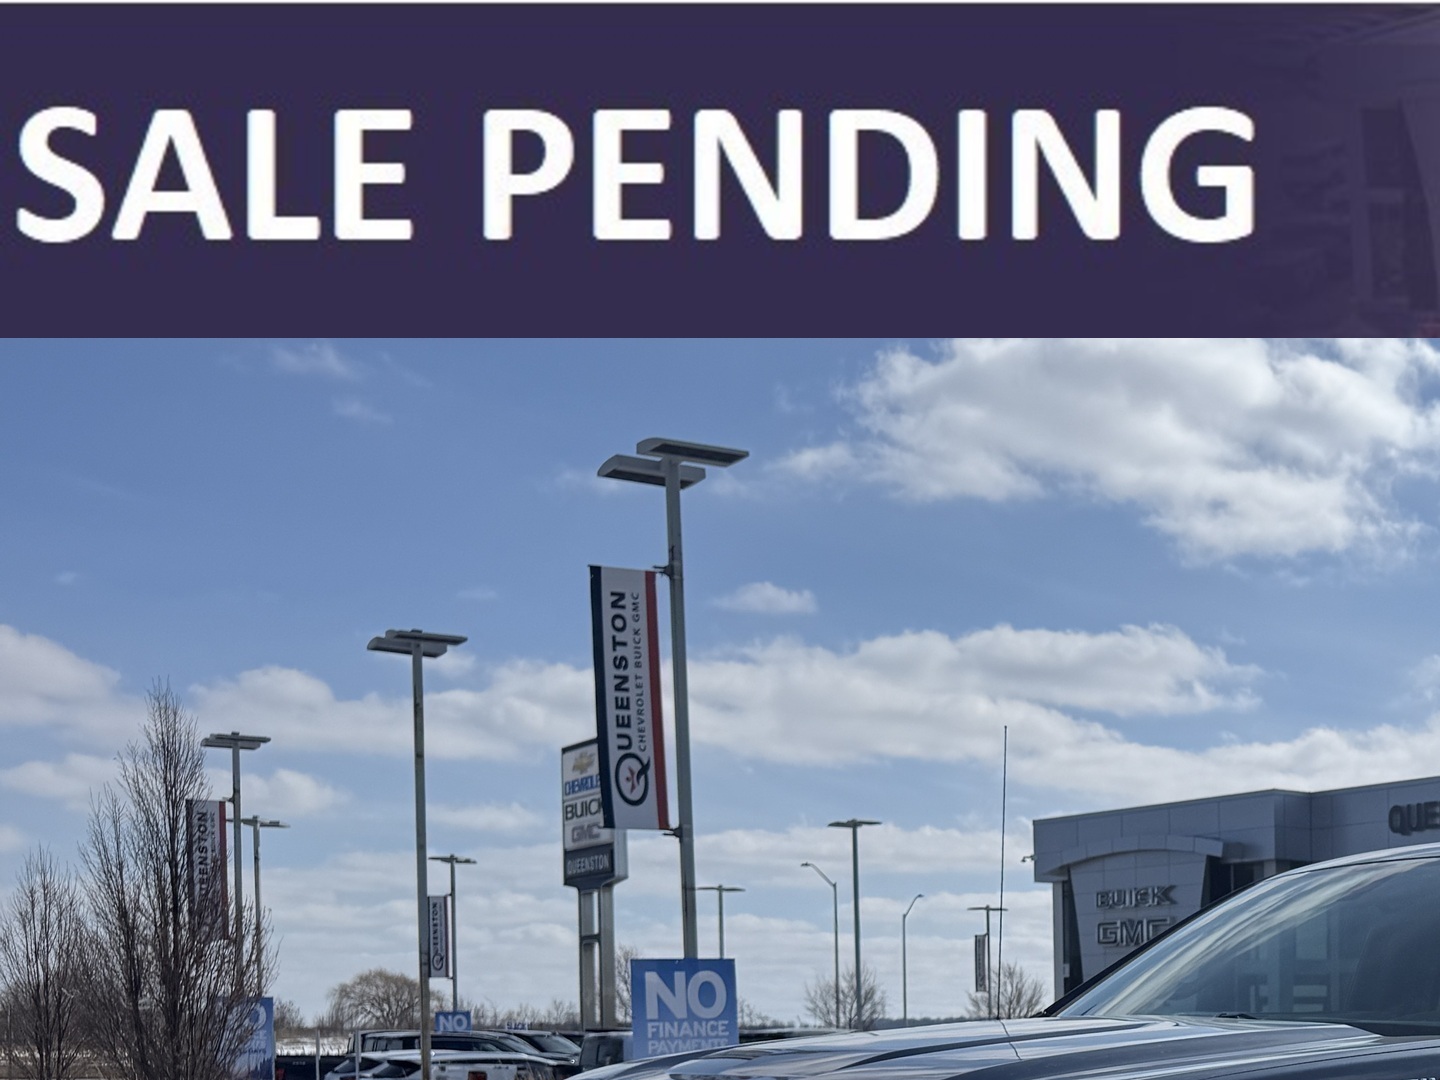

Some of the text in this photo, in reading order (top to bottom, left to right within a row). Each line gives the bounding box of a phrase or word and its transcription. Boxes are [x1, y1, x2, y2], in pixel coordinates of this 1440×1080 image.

[630, 591, 647, 752] CHEVROLET BUICK GMC
[610, 590, 651, 806] QUEENSTON
[565, 797, 603, 821] BUIC
[567, 853, 609, 874] QUEENSTON
[1097, 885, 1178, 909] BUICK
[645, 970, 726, 1020] NO
[439, 1014, 468, 1031] NO
[647, 1020, 729, 1039] FINANCE
